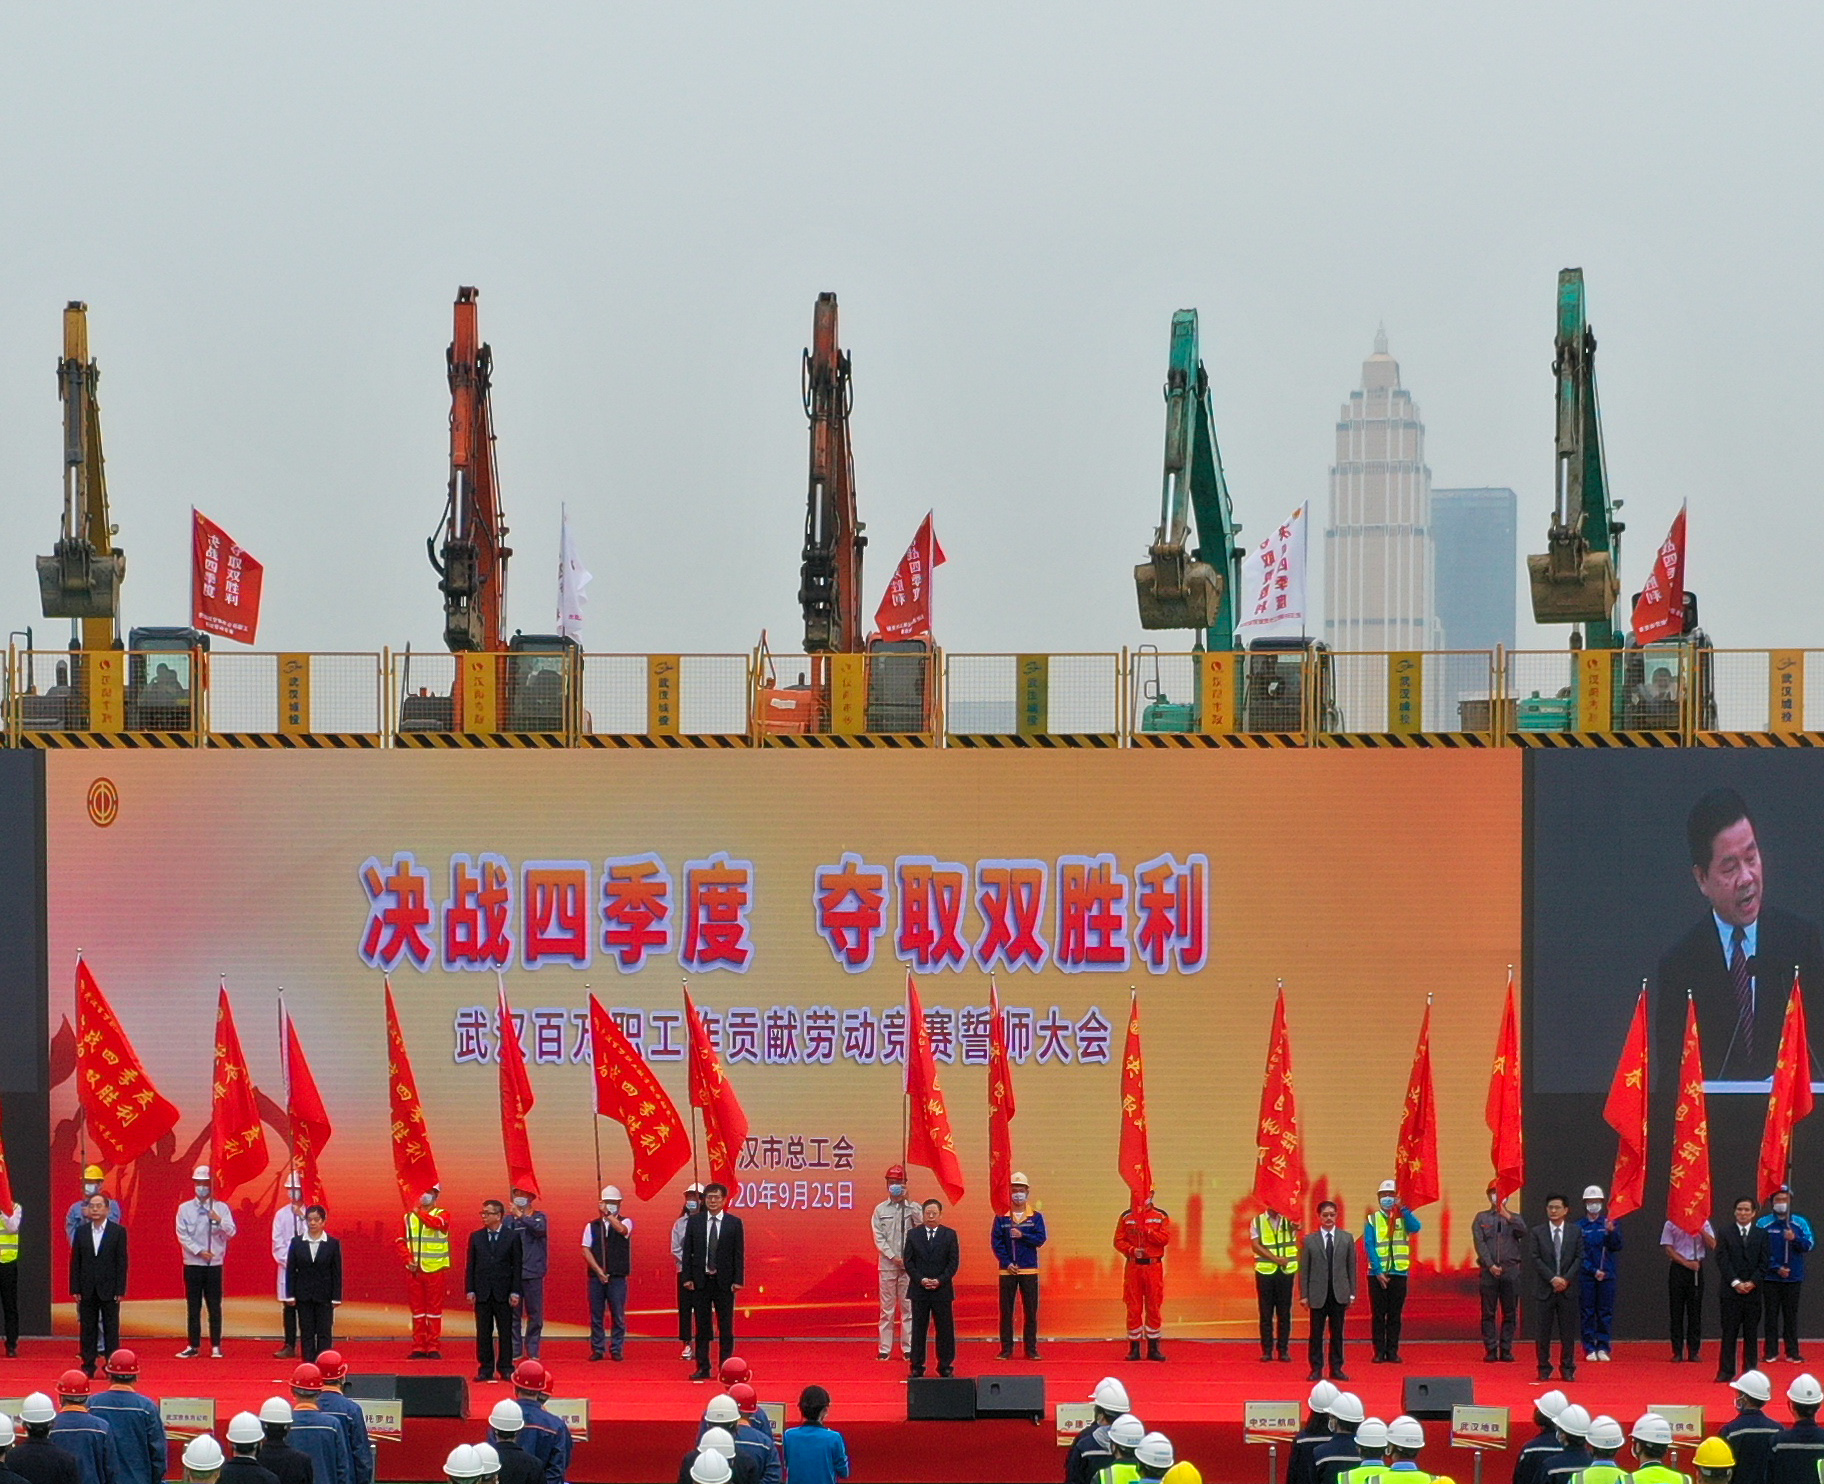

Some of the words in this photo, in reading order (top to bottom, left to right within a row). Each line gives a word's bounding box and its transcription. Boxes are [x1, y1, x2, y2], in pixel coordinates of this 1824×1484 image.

[204, 534, 220, 599] 决战四季度
[225, 543, 245, 607] 夺取双胜利
[363, 858, 753, 967] 决战四季度
[817, 860, 1205, 967] 夺取双胜利
[737, 1135, 855, 1170] 汉市总工会
[1249, 1418, 1296, 1429] 中交二航局
[1460, 1421, 1501, 1432] 武汉地铁
